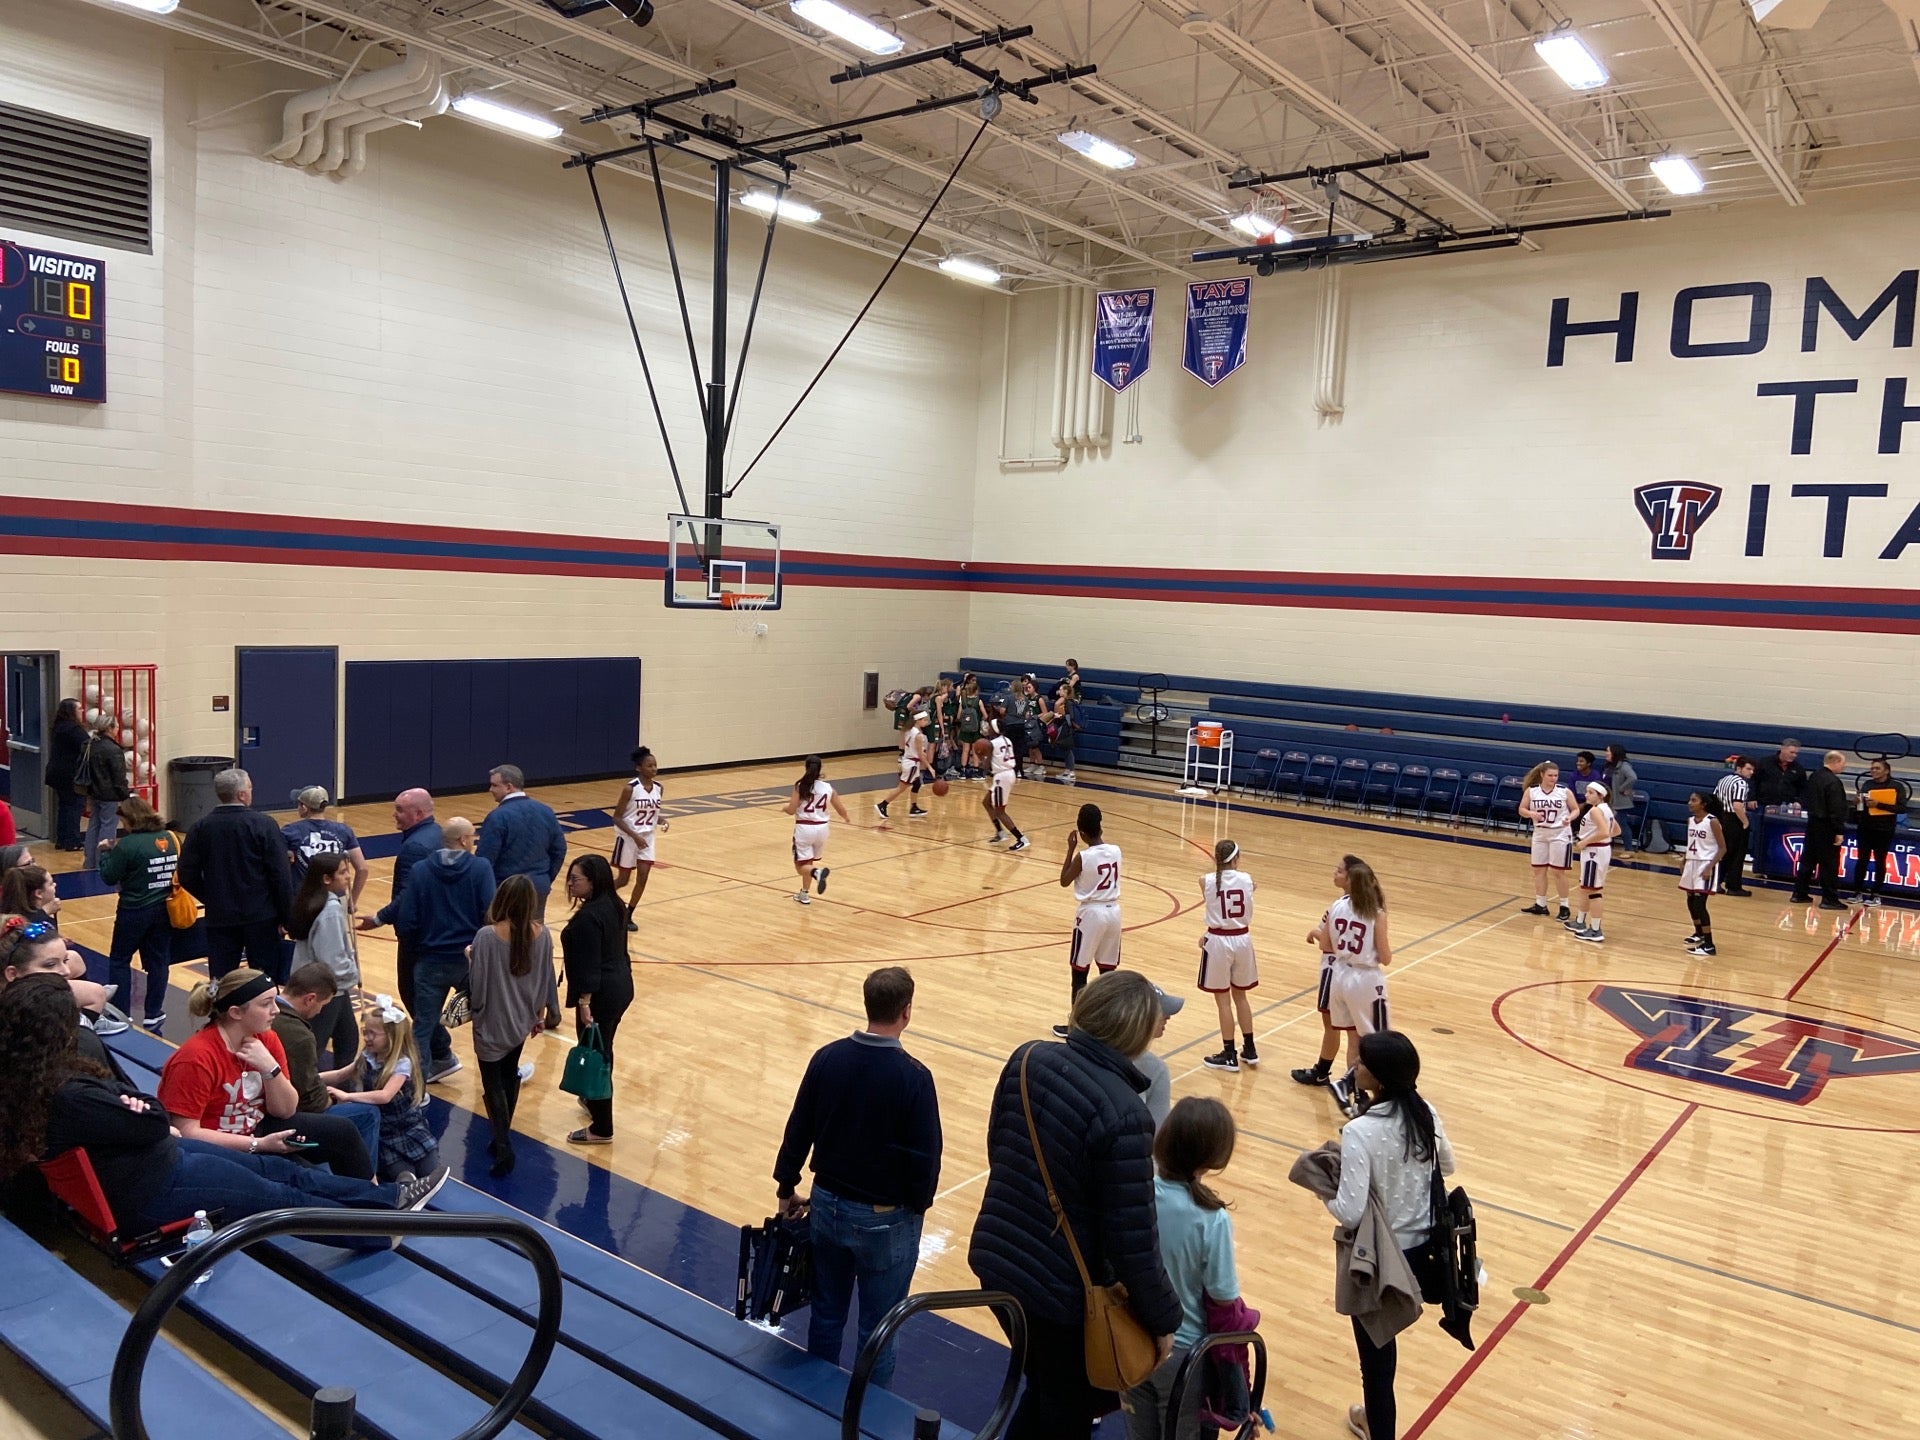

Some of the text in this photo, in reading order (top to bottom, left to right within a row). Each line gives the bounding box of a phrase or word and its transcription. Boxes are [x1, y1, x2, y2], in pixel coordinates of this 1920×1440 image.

[29, 254, 96, 282] VISITOR
[1193, 281, 1246, 300] TAYS
[1104, 293, 1150, 310] TAYS
[1190, 304, 1248, 319] CHAMPIONS
[46, 340, 79, 355] FOULS
[50, 384, 73, 395] WON
[634, 799, 660, 808] TITANS
[803, 793, 828, 813] 24
[1532, 799, 1562, 809] TITANS
[634, 810, 656, 826] 22
[1537, 809, 1558, 824] 30
[1688, 839, 1698, 855] 4
[1895, 844, 1915, 853] OF
[1096, 861, 1119, 891] 21
[1216, 889, 1246, 920] 13
[1334, 918, 1367, 955] 23
